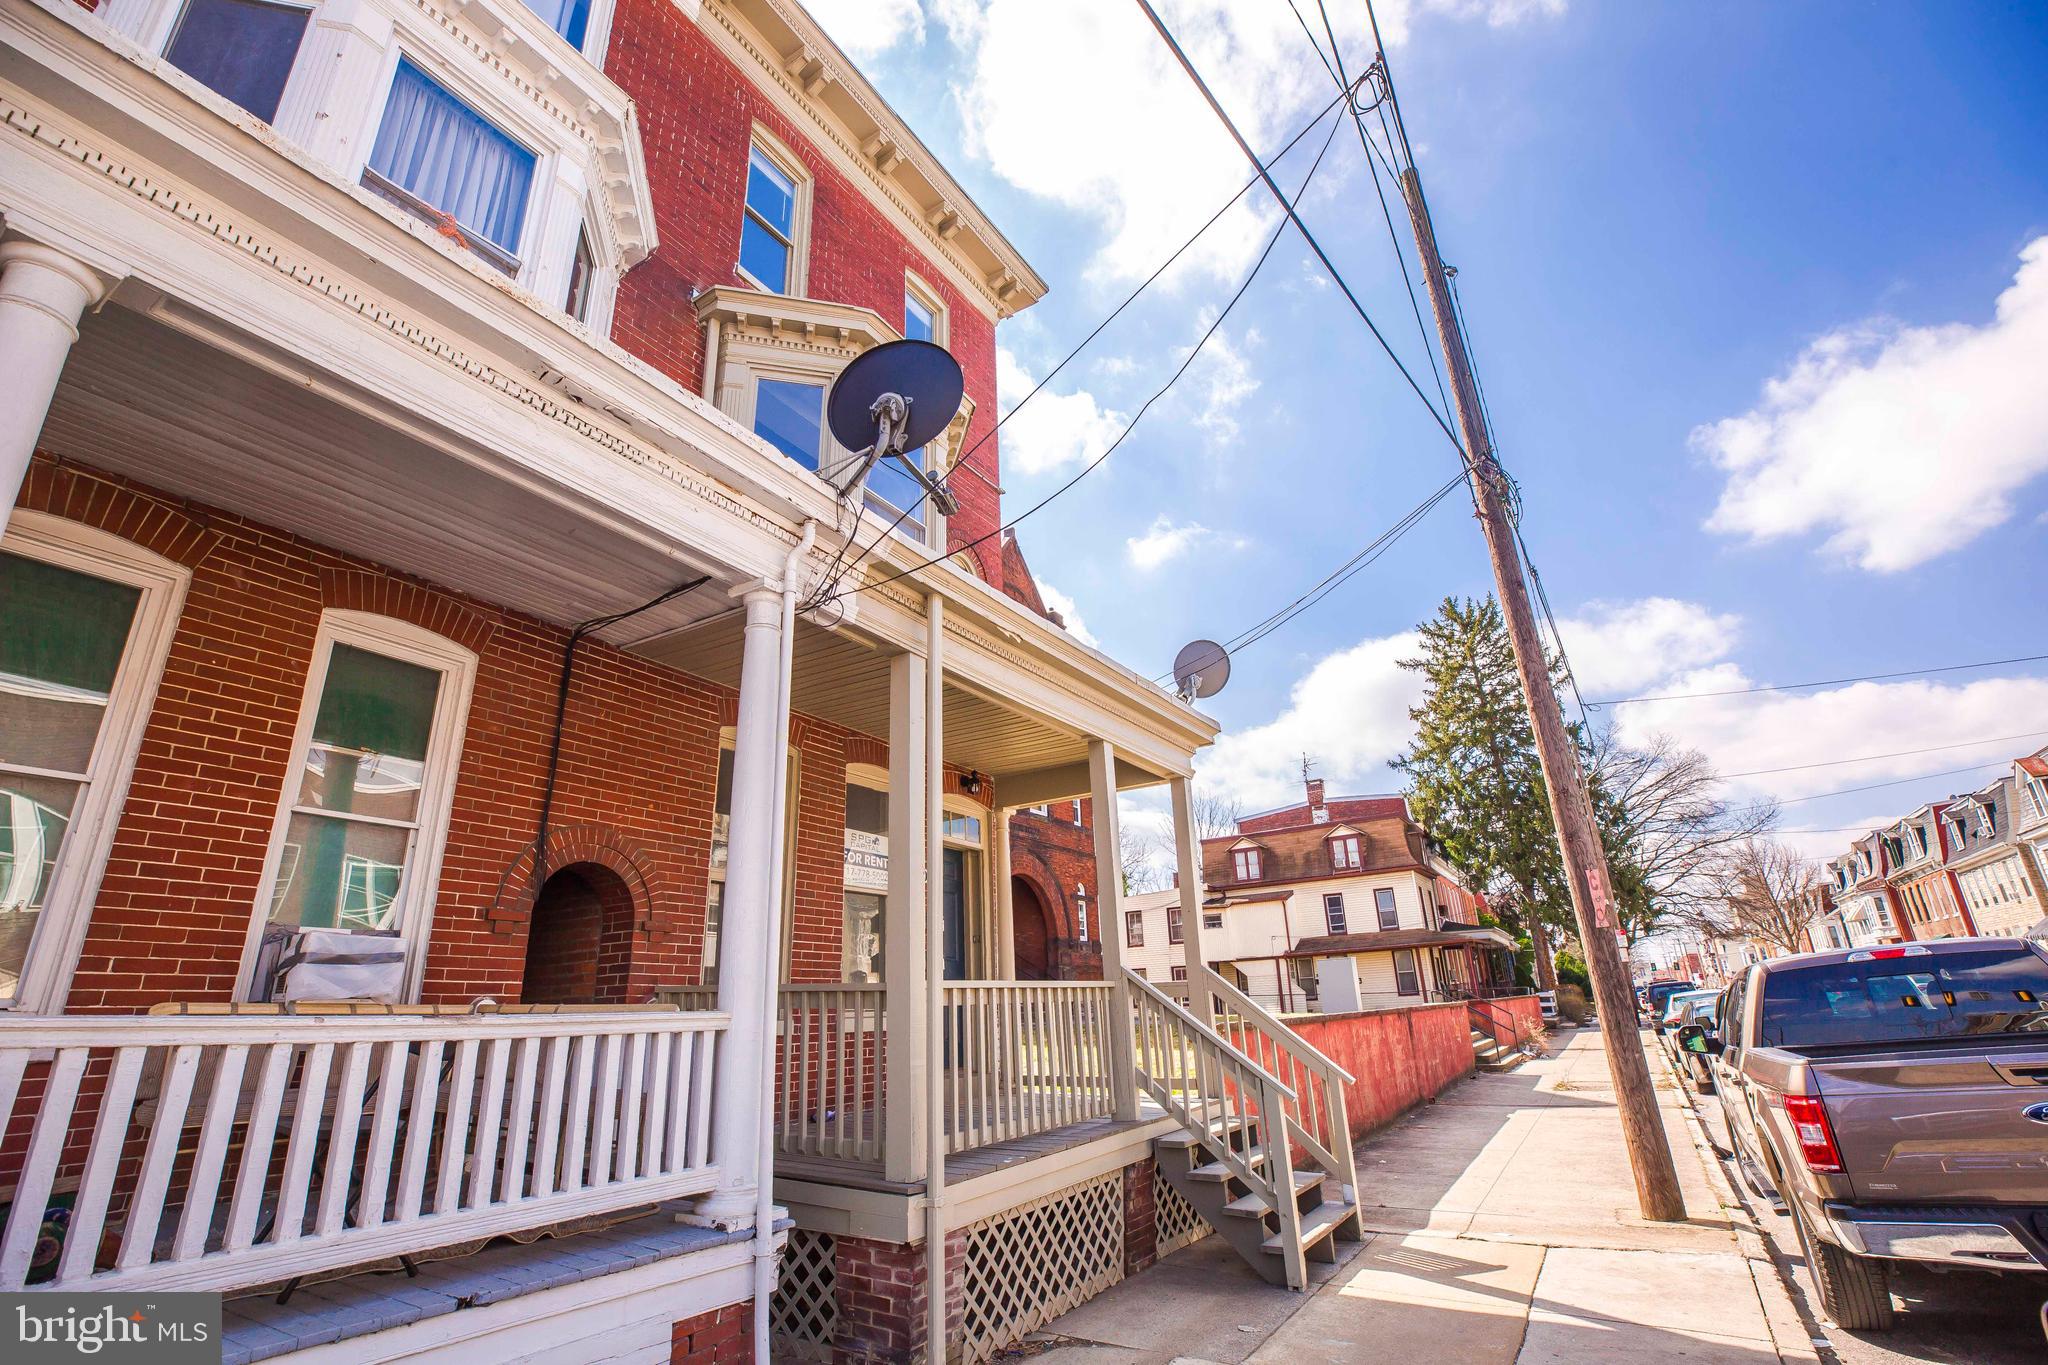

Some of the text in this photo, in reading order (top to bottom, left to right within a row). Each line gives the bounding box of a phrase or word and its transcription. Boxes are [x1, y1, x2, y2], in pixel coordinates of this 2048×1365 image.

[850, 832, 872, 844] SPG
[850, 841, 881, 853] CAPITAL
[844, 850, 888, 869] FOR RENT
